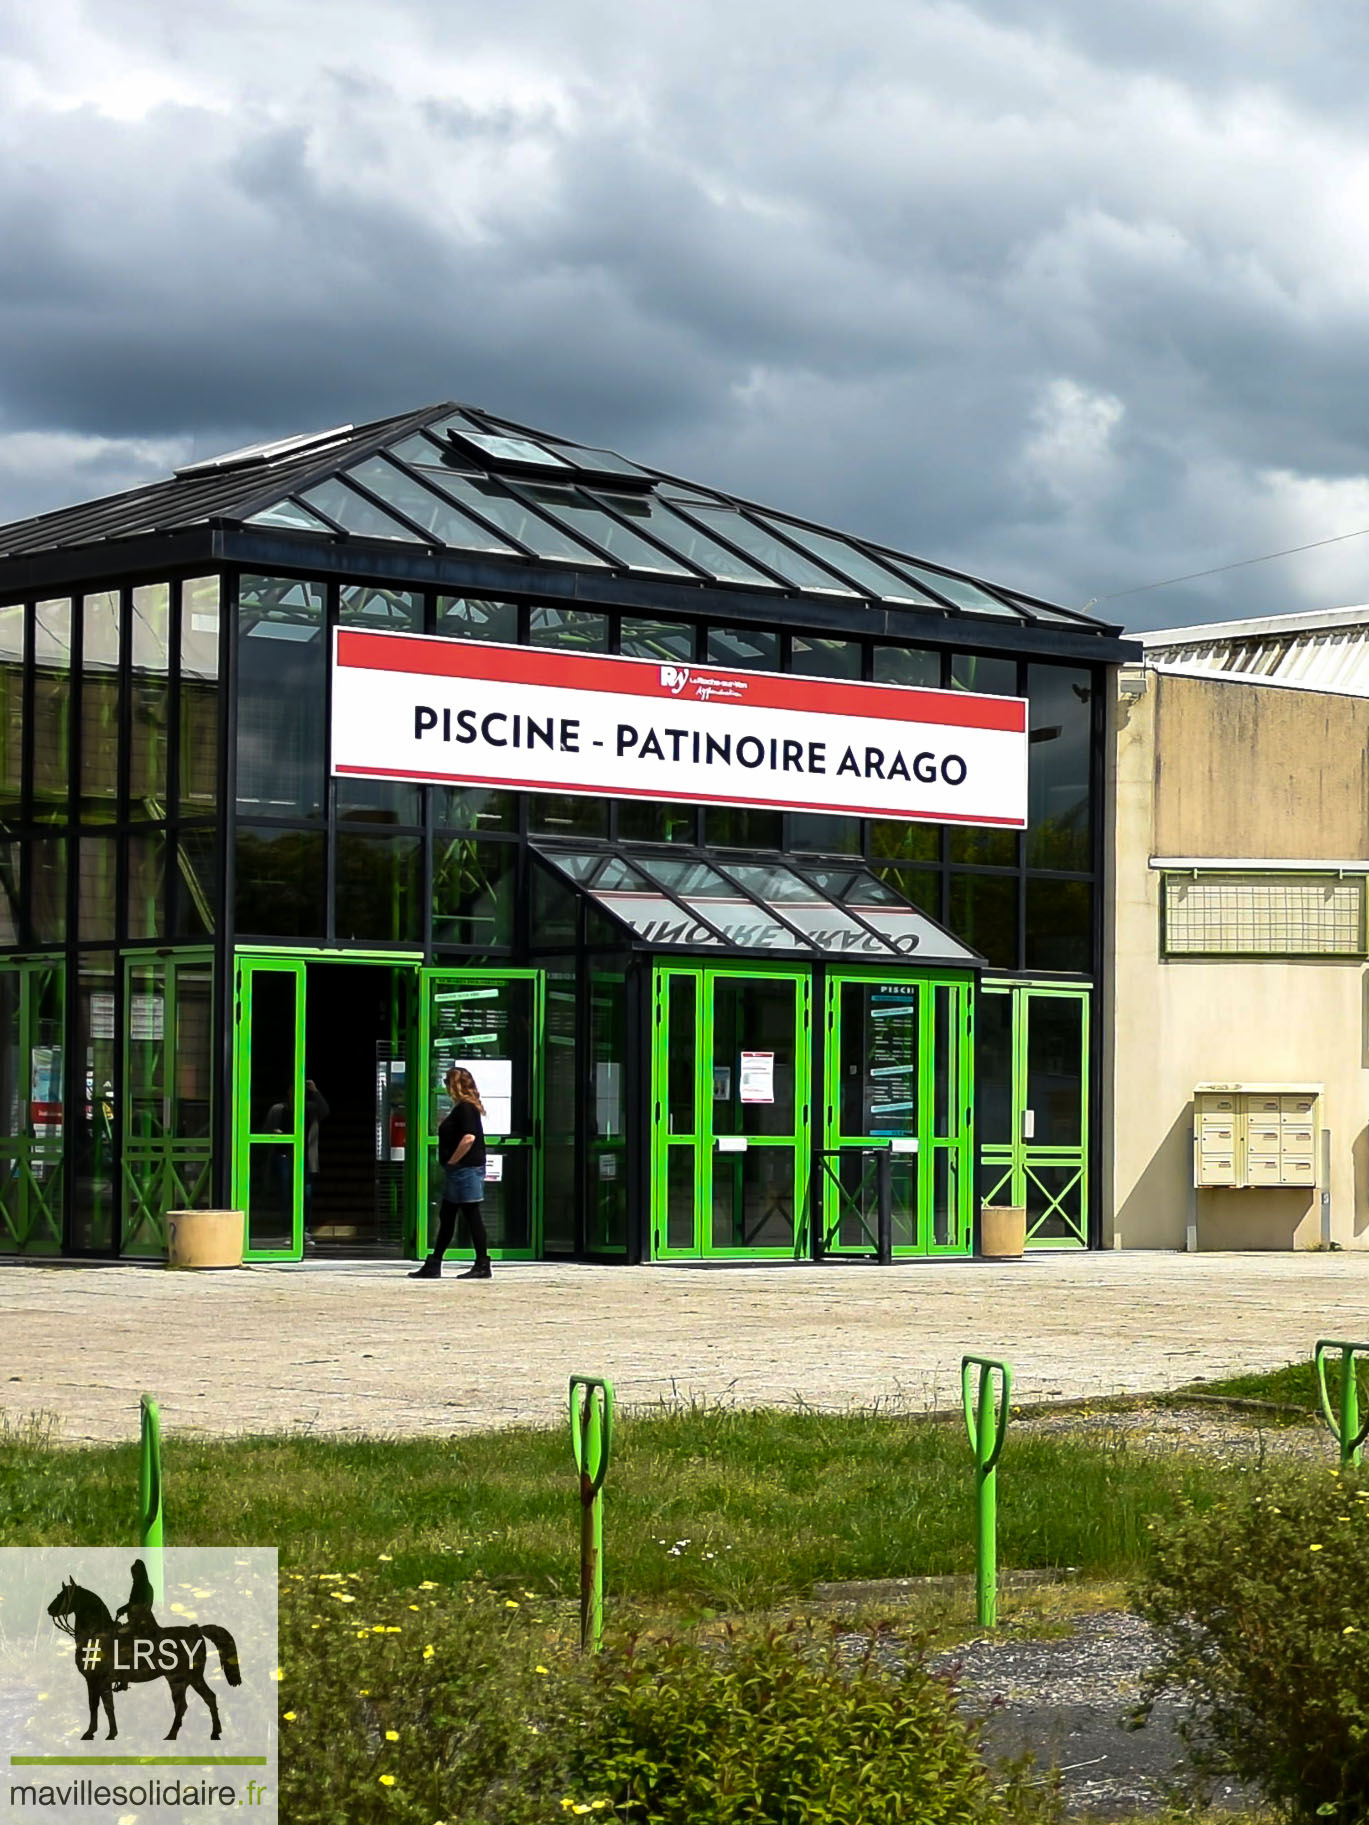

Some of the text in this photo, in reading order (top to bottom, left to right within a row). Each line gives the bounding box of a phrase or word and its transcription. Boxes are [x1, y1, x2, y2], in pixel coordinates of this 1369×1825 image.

[414, 705, 580, 753] PISCINE
[616, 724, 826, 774] PATINOIRE
[836, 745, 967, 786] ARAGO
